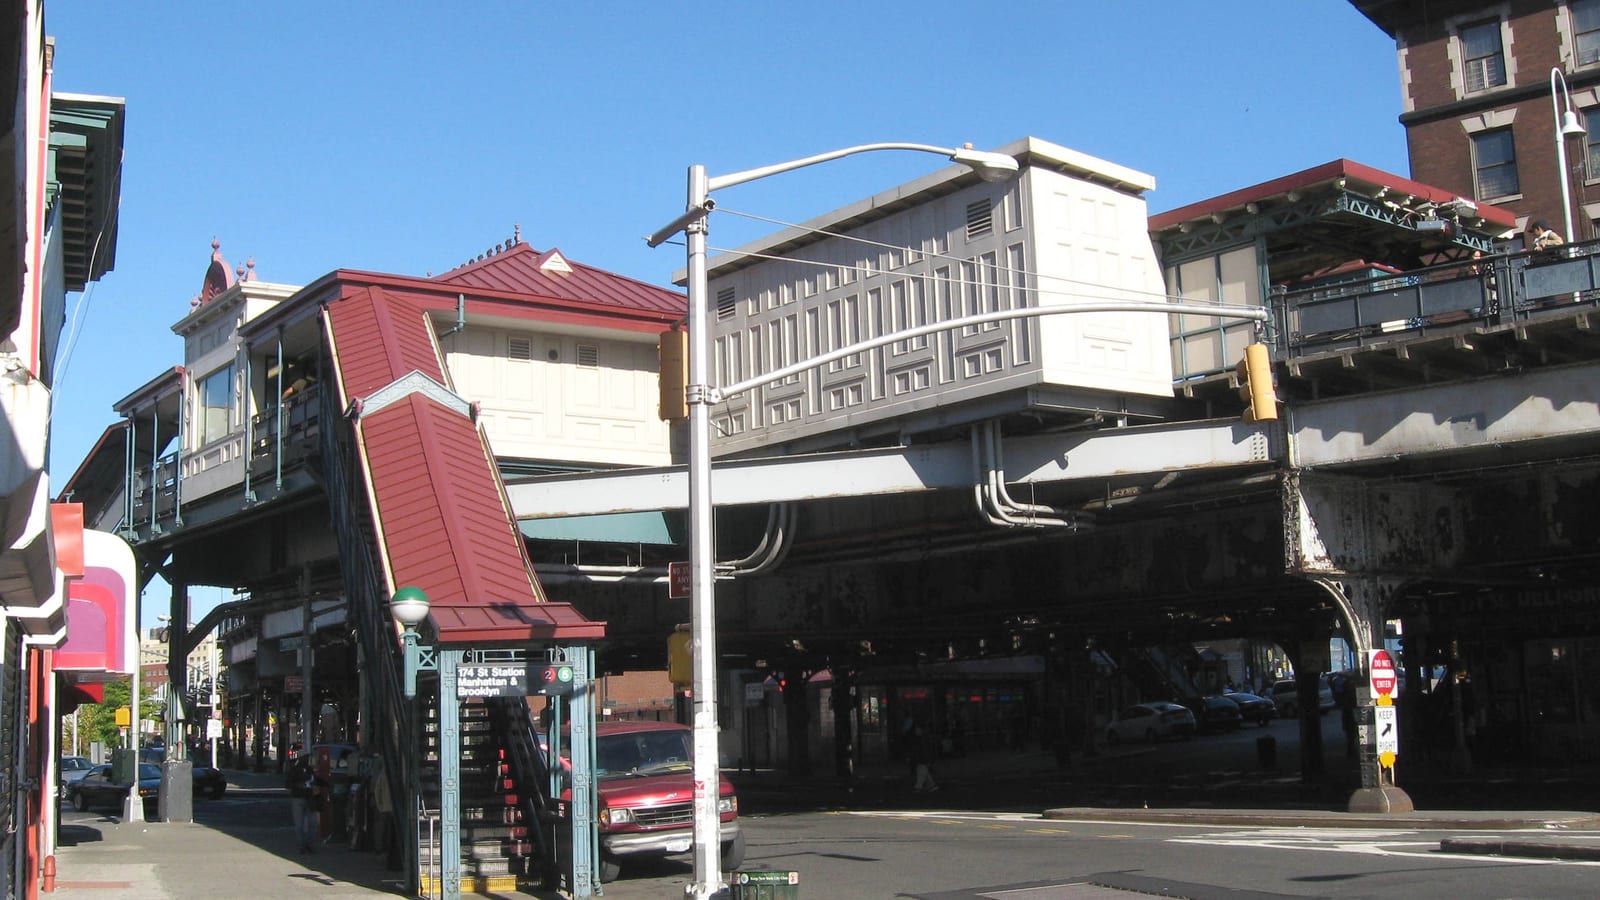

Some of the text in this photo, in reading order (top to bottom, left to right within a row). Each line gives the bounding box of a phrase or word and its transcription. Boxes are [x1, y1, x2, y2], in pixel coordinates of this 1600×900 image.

[1374, 660, 1391, 668] DO NOT
[457, 667, 525, 677] 174 St Station
[544, 670, 552, 680] 2
[457, 676, 517, 686] Manhattan &
[1376, 680, 1392, 688] ENTER
[457, 687, 500, 697] Brooklyn
[1378, 710, 1393, 720] KEEP
[1379, 741, 1396, 751] RIGHT
